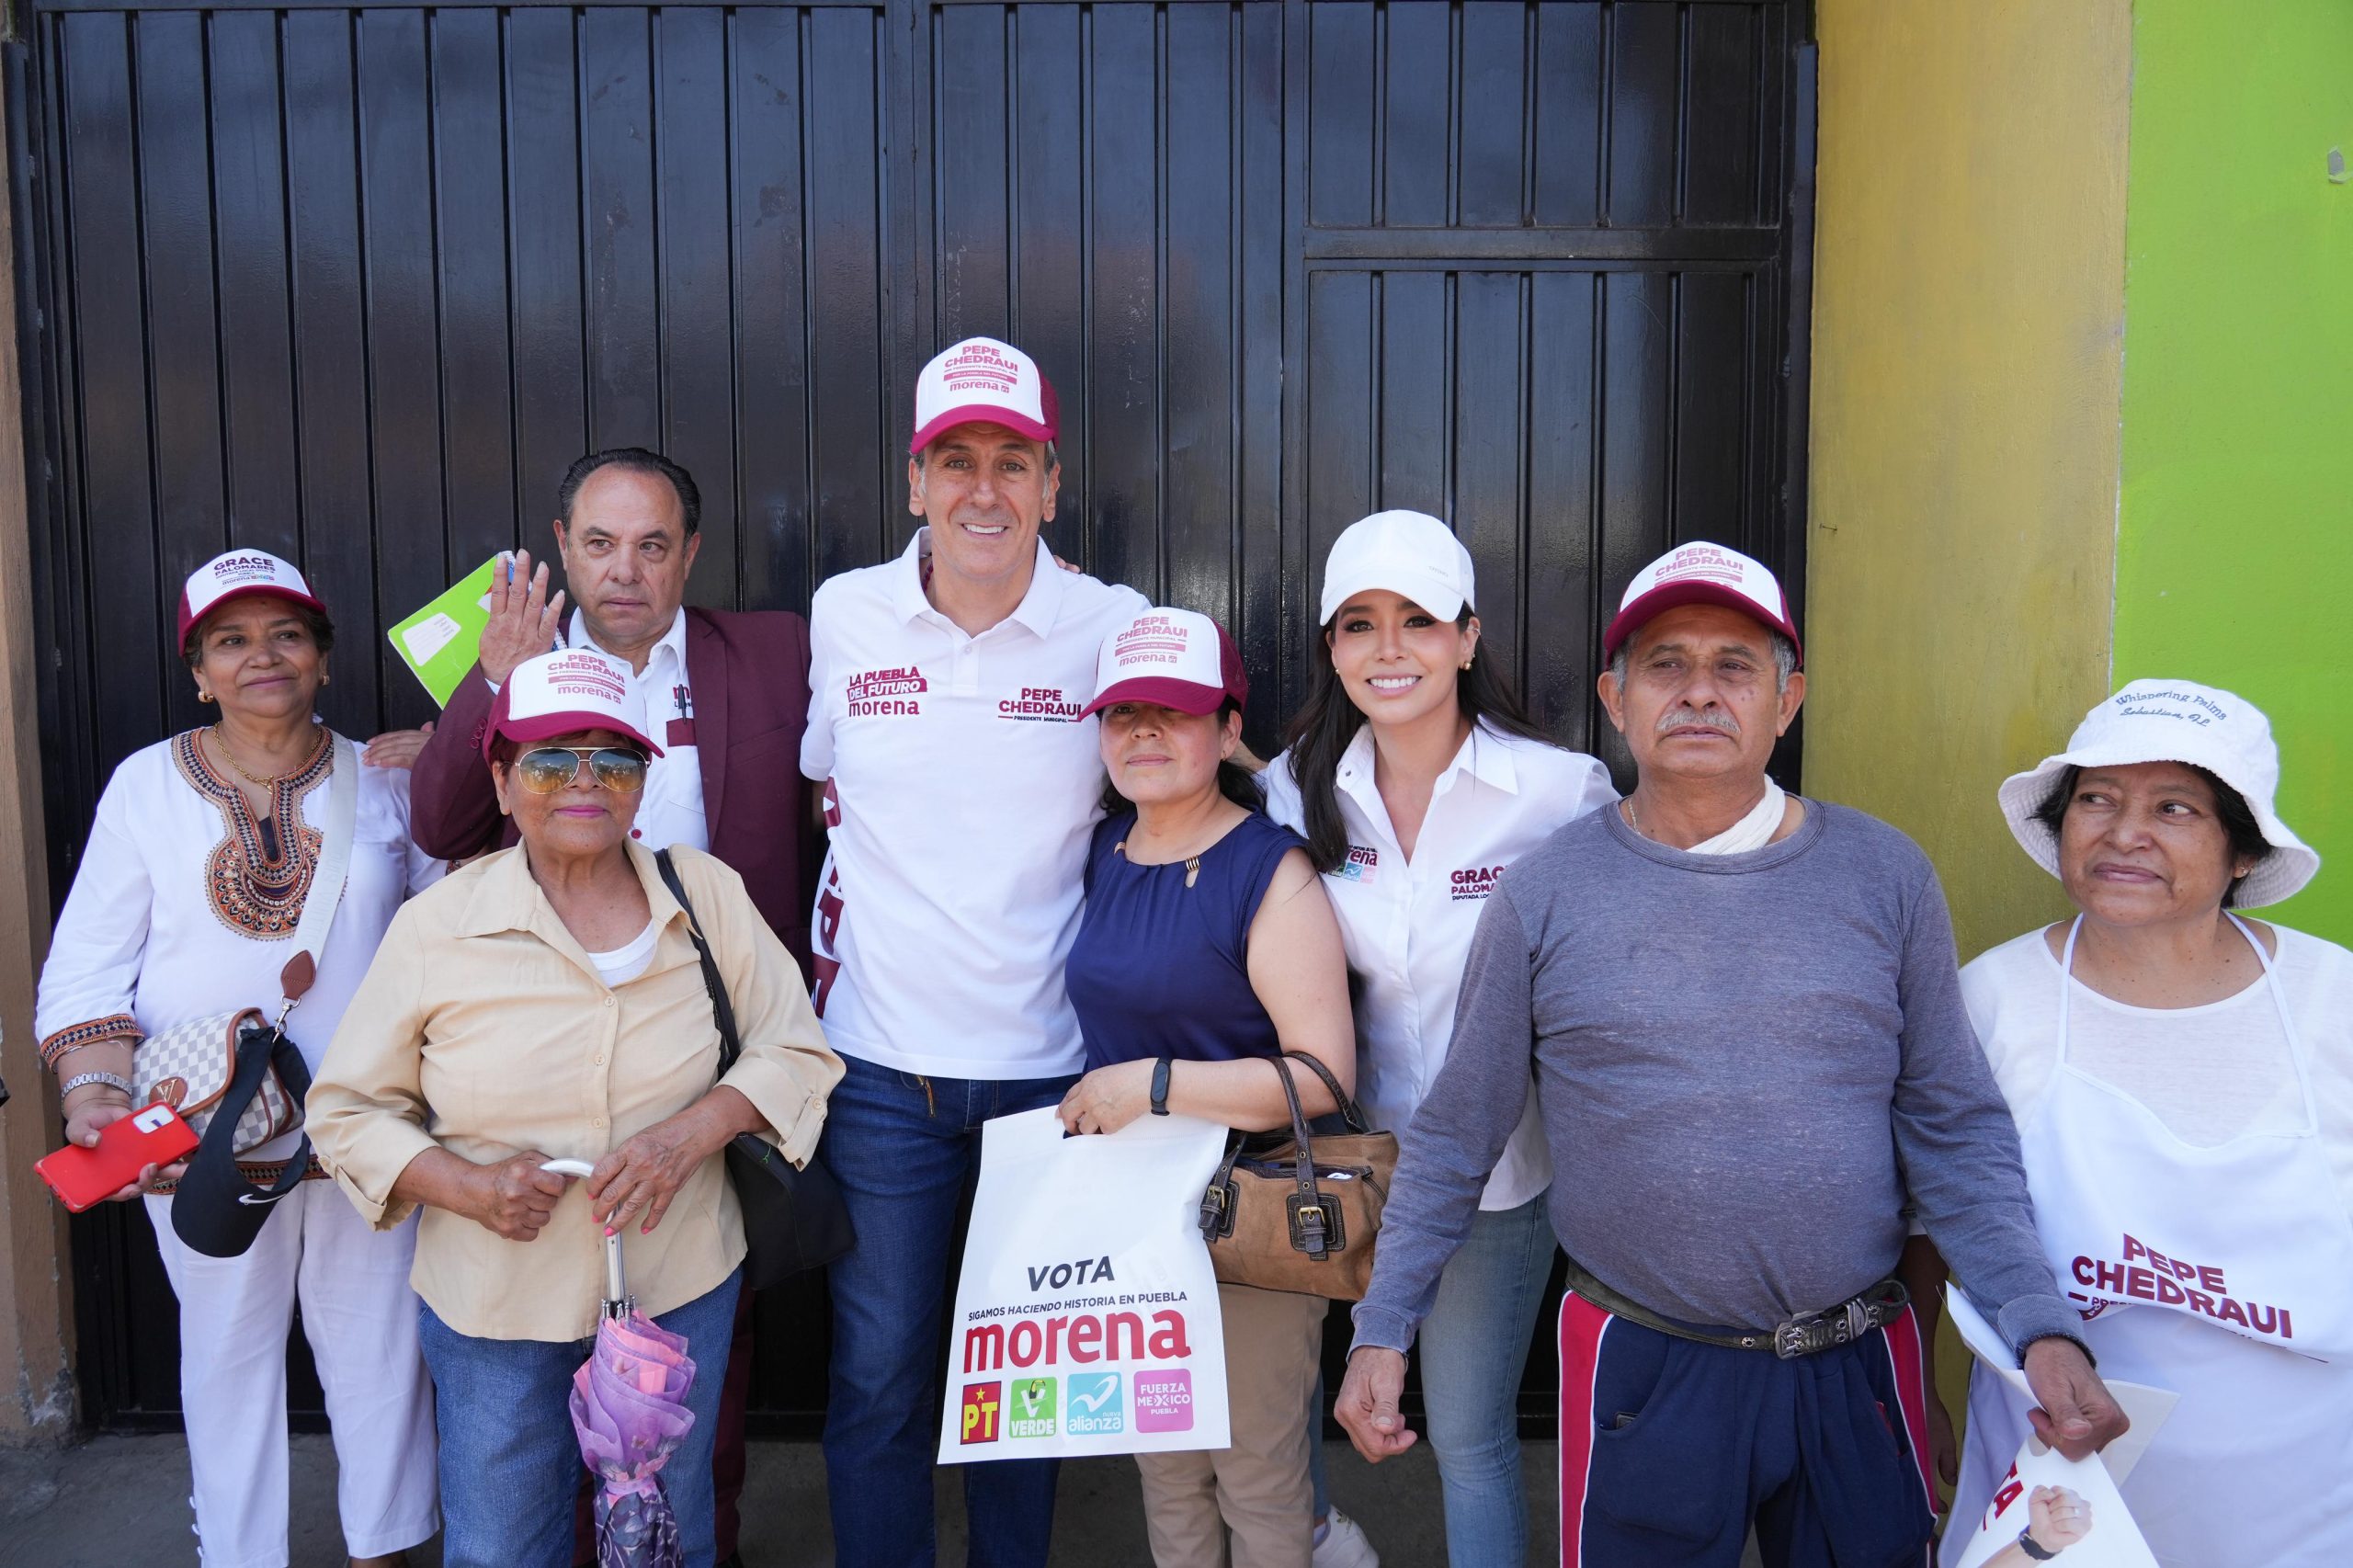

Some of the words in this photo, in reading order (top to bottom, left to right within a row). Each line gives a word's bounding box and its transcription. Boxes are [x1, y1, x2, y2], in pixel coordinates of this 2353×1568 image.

[962, 346, 1000, 357] PEPE
[945, 355, 1017, 372] CHEDRAUI
[949, 381, 999, 392] morena
[1676, 547, 1722, 560] PEPE
[214, 557, 274, 571] GRACE
[215, 565, 276, 576] PALOMARES
[1654, 556, 1743, 576] CHEDRAUI
[1133, 617, 1169, 629] PEPE
[1117, 626, 1188, 642] CHEDRAUI
[567, 654, 607, 667] PEPE
[1119, 653, 1166, 666] morena
[548, 662, 625, 684] CHEDRAUI
[849, 674, 861, 687] LA
[864, 666, 920, 683] PUEBLA
[558, 686, 612, 700] morena
[848, 687, 866, 700] DEL
[868, 680, 921, 697] FUTURO
[1021, 687, 1062, 701] PEPE
[848, 700, 920, 717] morena
[999, 700, 1081, 715] CHEDRAUI
[2116, 690, 2190, 705] Whispering
[2192, 695, 2227, 720] Palms
[1450, 866, 1506, 884] GRAC
[2122, 1233, 2227, 1295] PEPE
[1028, 1256, 1115, 1291] VOTA
[968, 1307, 1006, 1321] SIGAMOS
[1007, 1301, 1062, 1315] HACIENDO
[1064, 1296, 1116, 1309] HISTORIA
[1119, 1294, 1135, 1304] EN
[1138, 1291, 1188, 1303] PUEBLA
[2072, 1256, 2292, 1339] CHEDRAUI
[963, 1309, 1192, 1374] morena
[1141, 1382, 1186, 1394] FUERZA
[1151, 1407, 1178, 1415] PUEBLA
[962, 1402, 998, 1440] PT
[1011, 1418, 1055, 1437] VERDE
[1068, 1415, 1121, 1432] alianza
